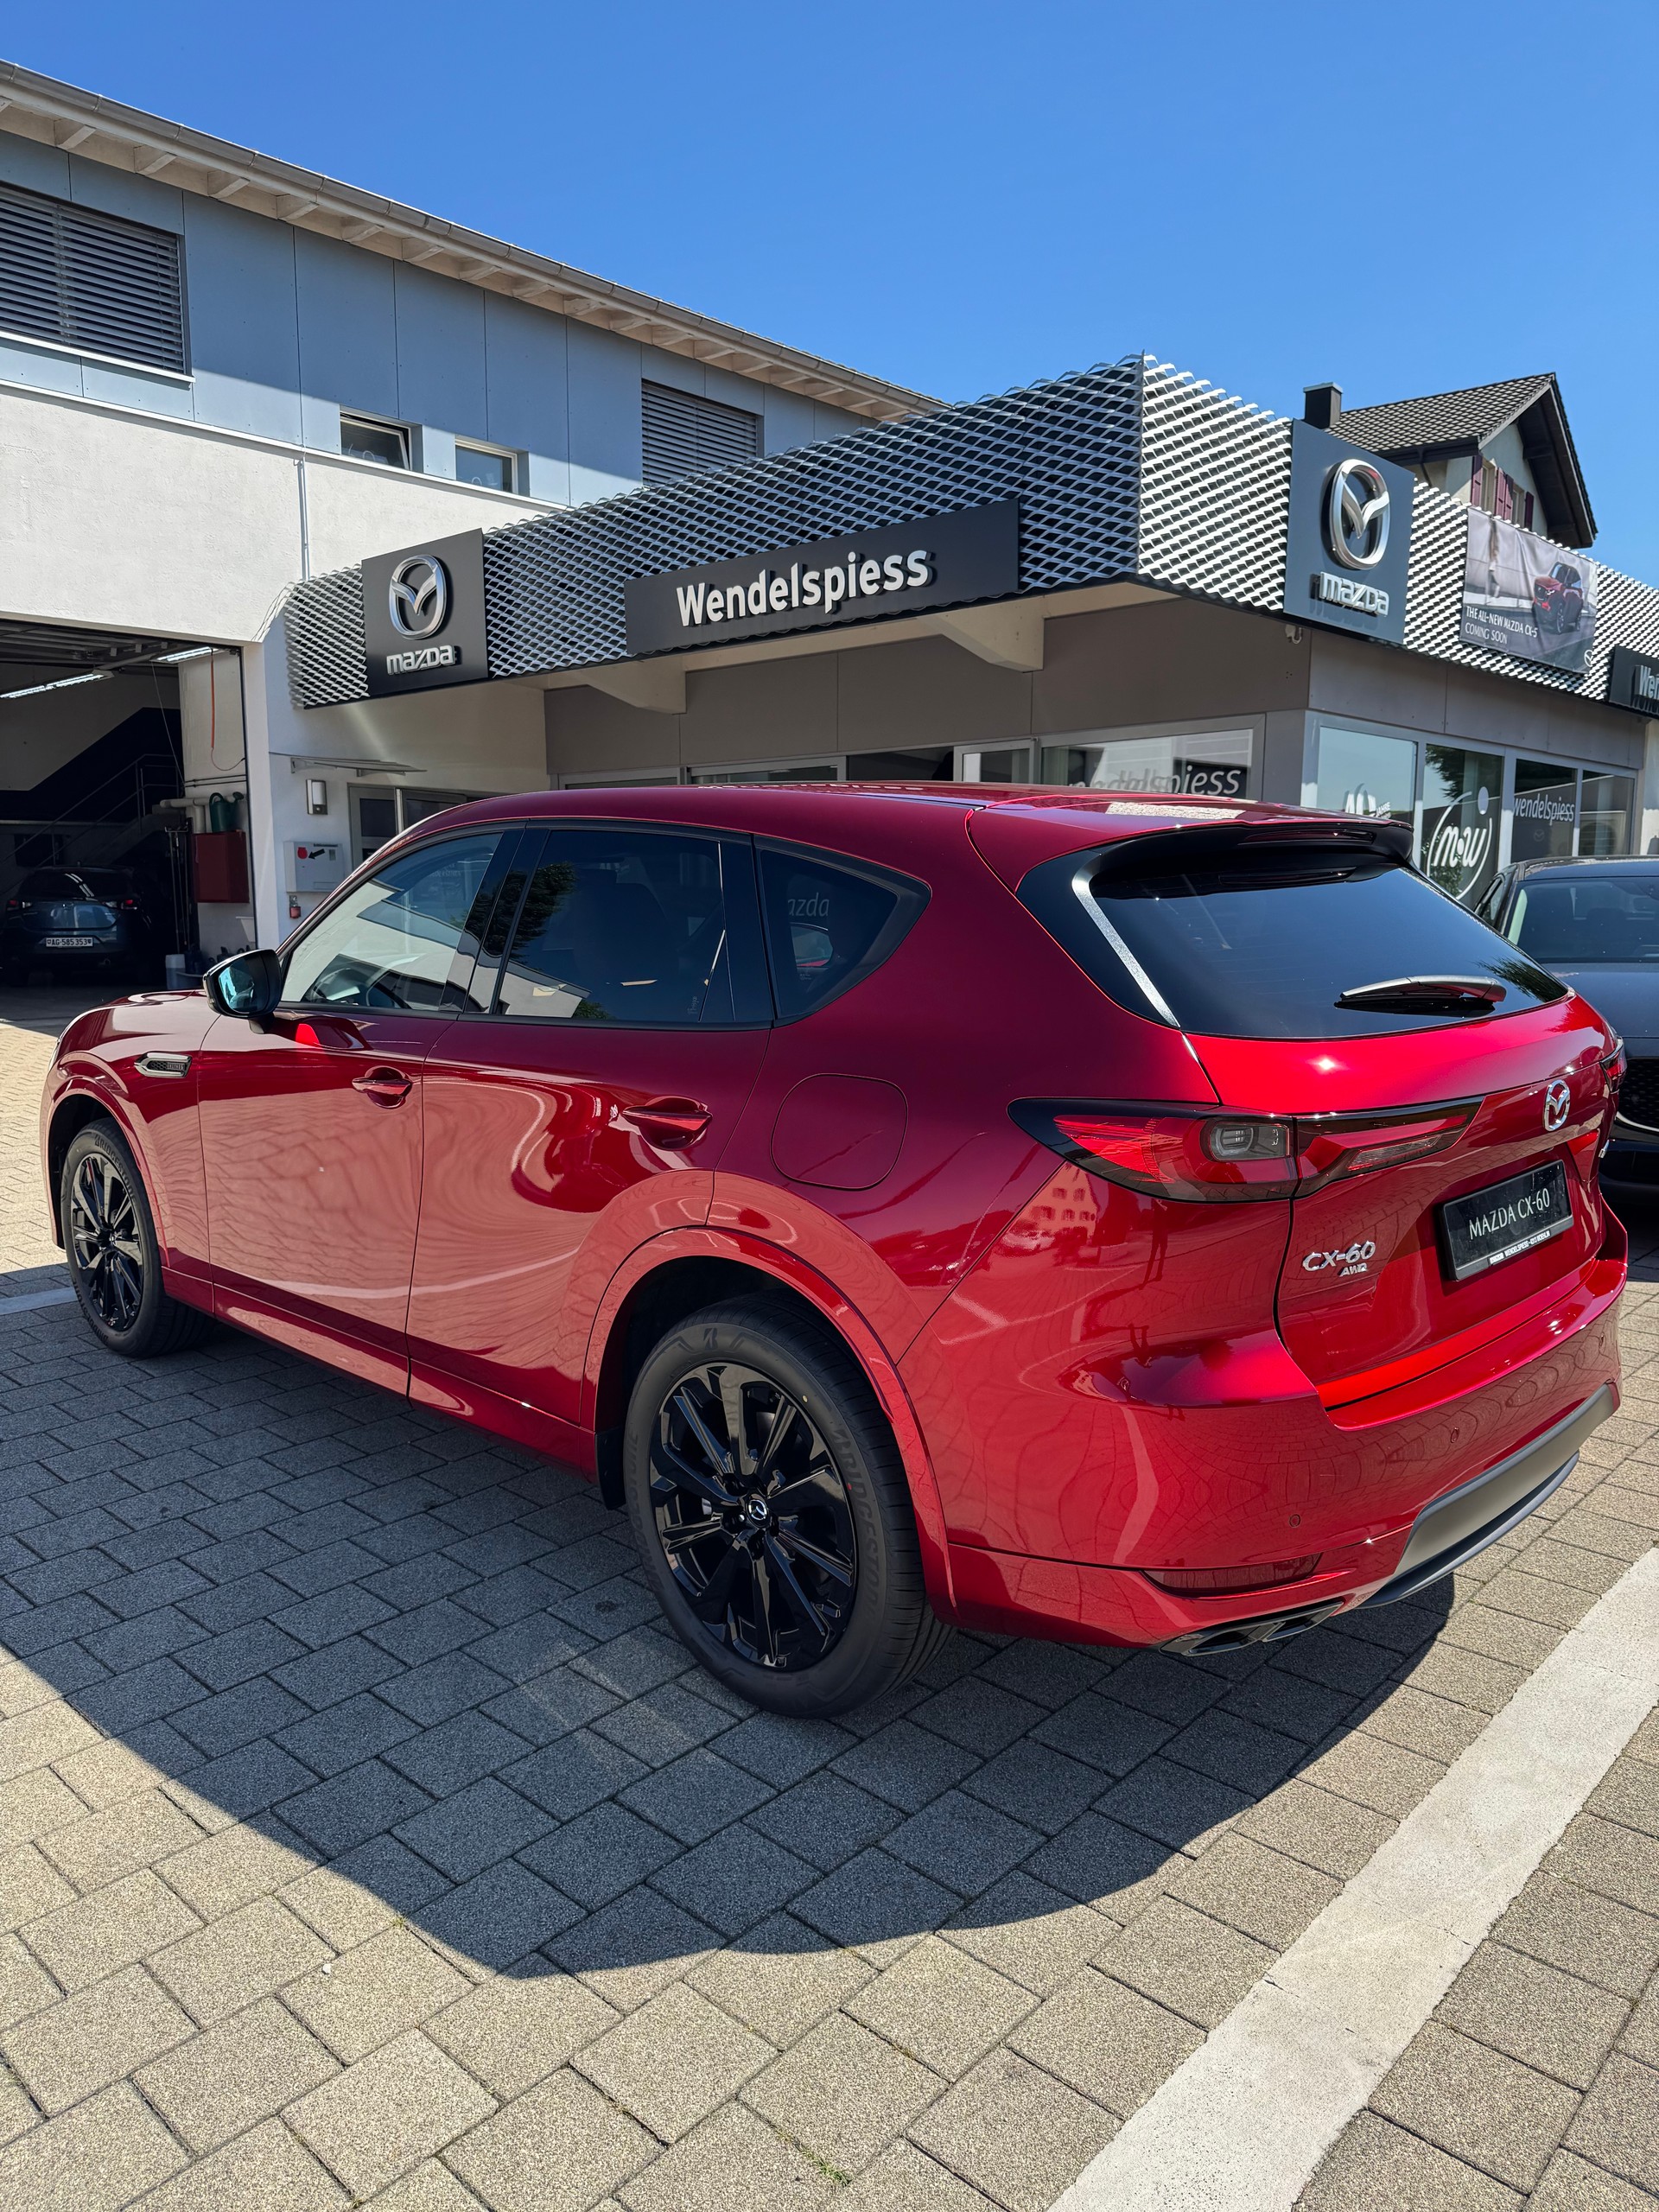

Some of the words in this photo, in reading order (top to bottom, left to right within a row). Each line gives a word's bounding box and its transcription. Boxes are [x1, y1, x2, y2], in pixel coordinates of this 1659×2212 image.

[677, 550, 928, 626] Wendelspiess
[1465, 622, 1490, 639] COMING
[1491, 629, 1508, 644] SOON
[1466, 606, 1478, 619] THE
[1478, 609, 1503, 626] ALL-NEW
[1503, 616, 1523, 634] MAZDA
[1525, 624, 1538, 638] CX-5
[1469, 1204, 1516, 1240] MAZDA
[1517, 1188, 1550, 1219] CX-60
[1302, 1240, 1376, 1272] CX-60
[1338, 1262, 1368, 1277] AWD
